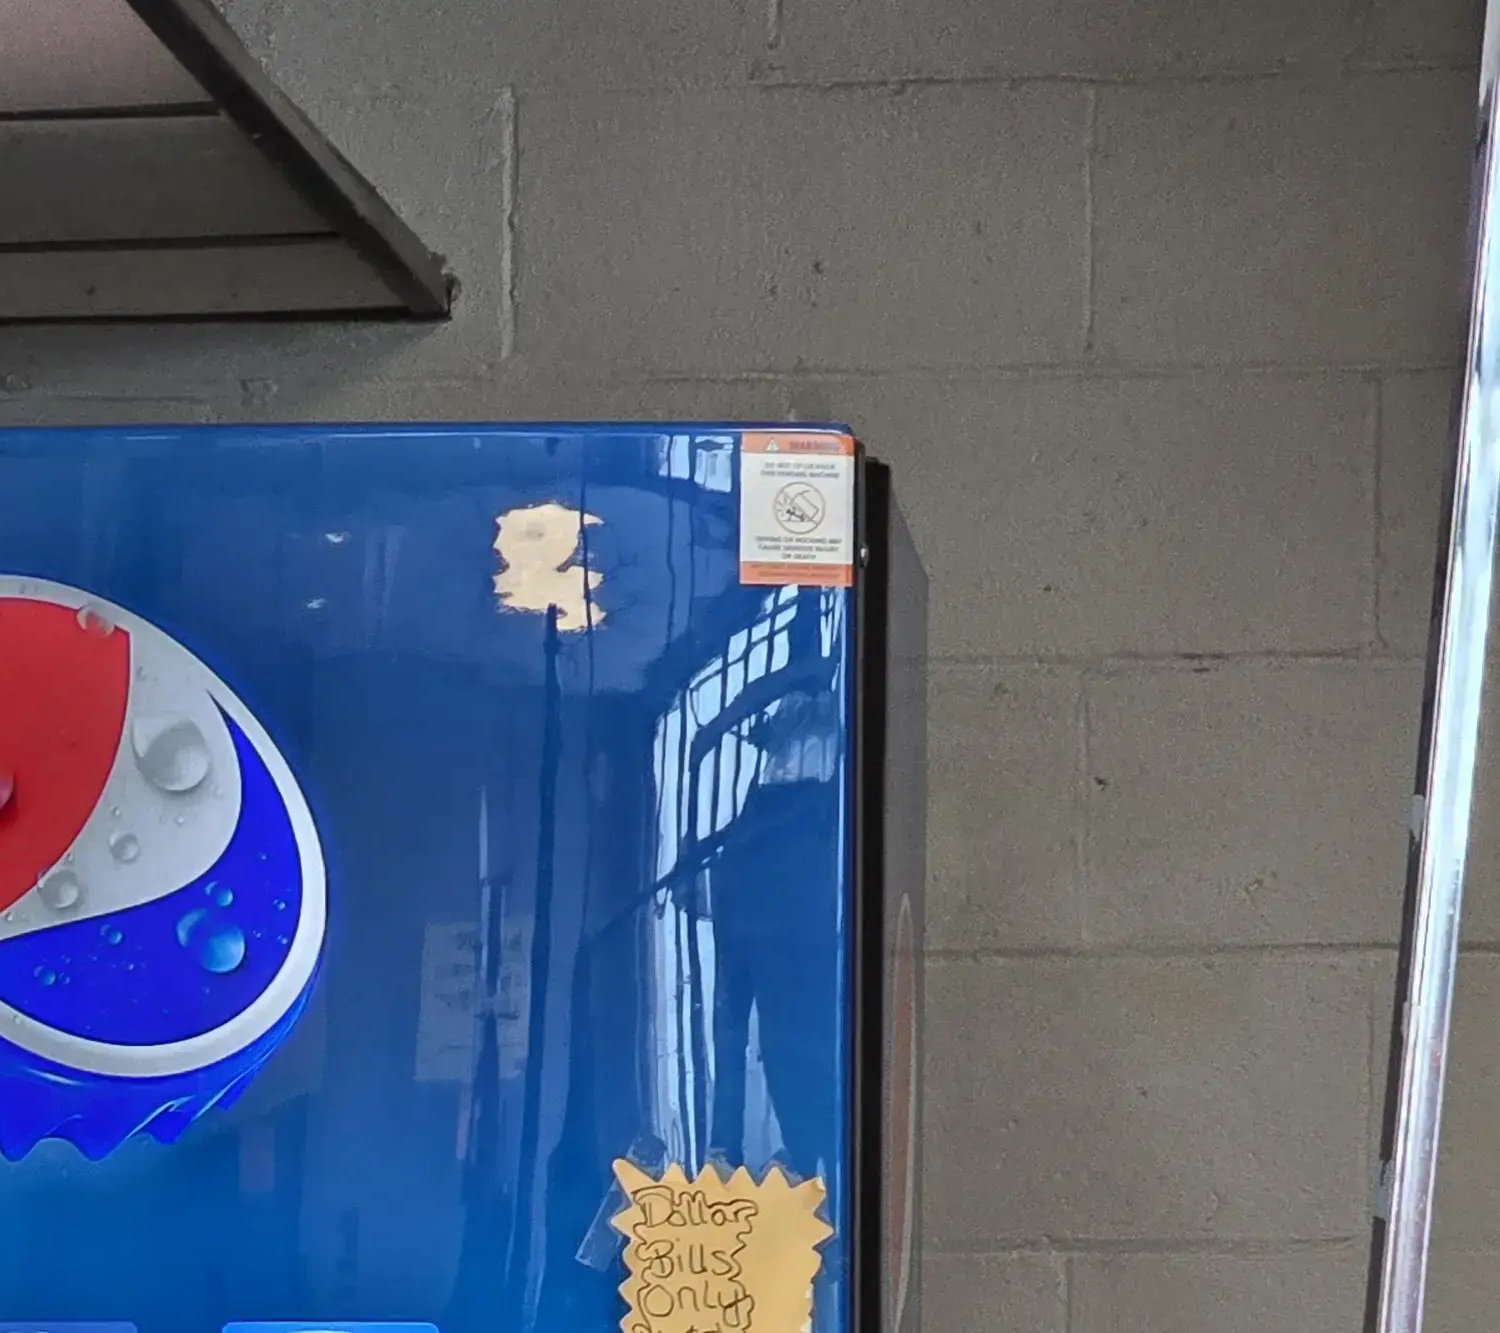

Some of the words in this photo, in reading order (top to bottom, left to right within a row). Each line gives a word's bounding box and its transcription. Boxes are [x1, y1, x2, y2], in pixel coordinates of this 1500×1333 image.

[640, 1192, 751, 1228] Dollar
[650, 1238, 732, 1278] Bills
[643, 1280, 743, 1327] Only
